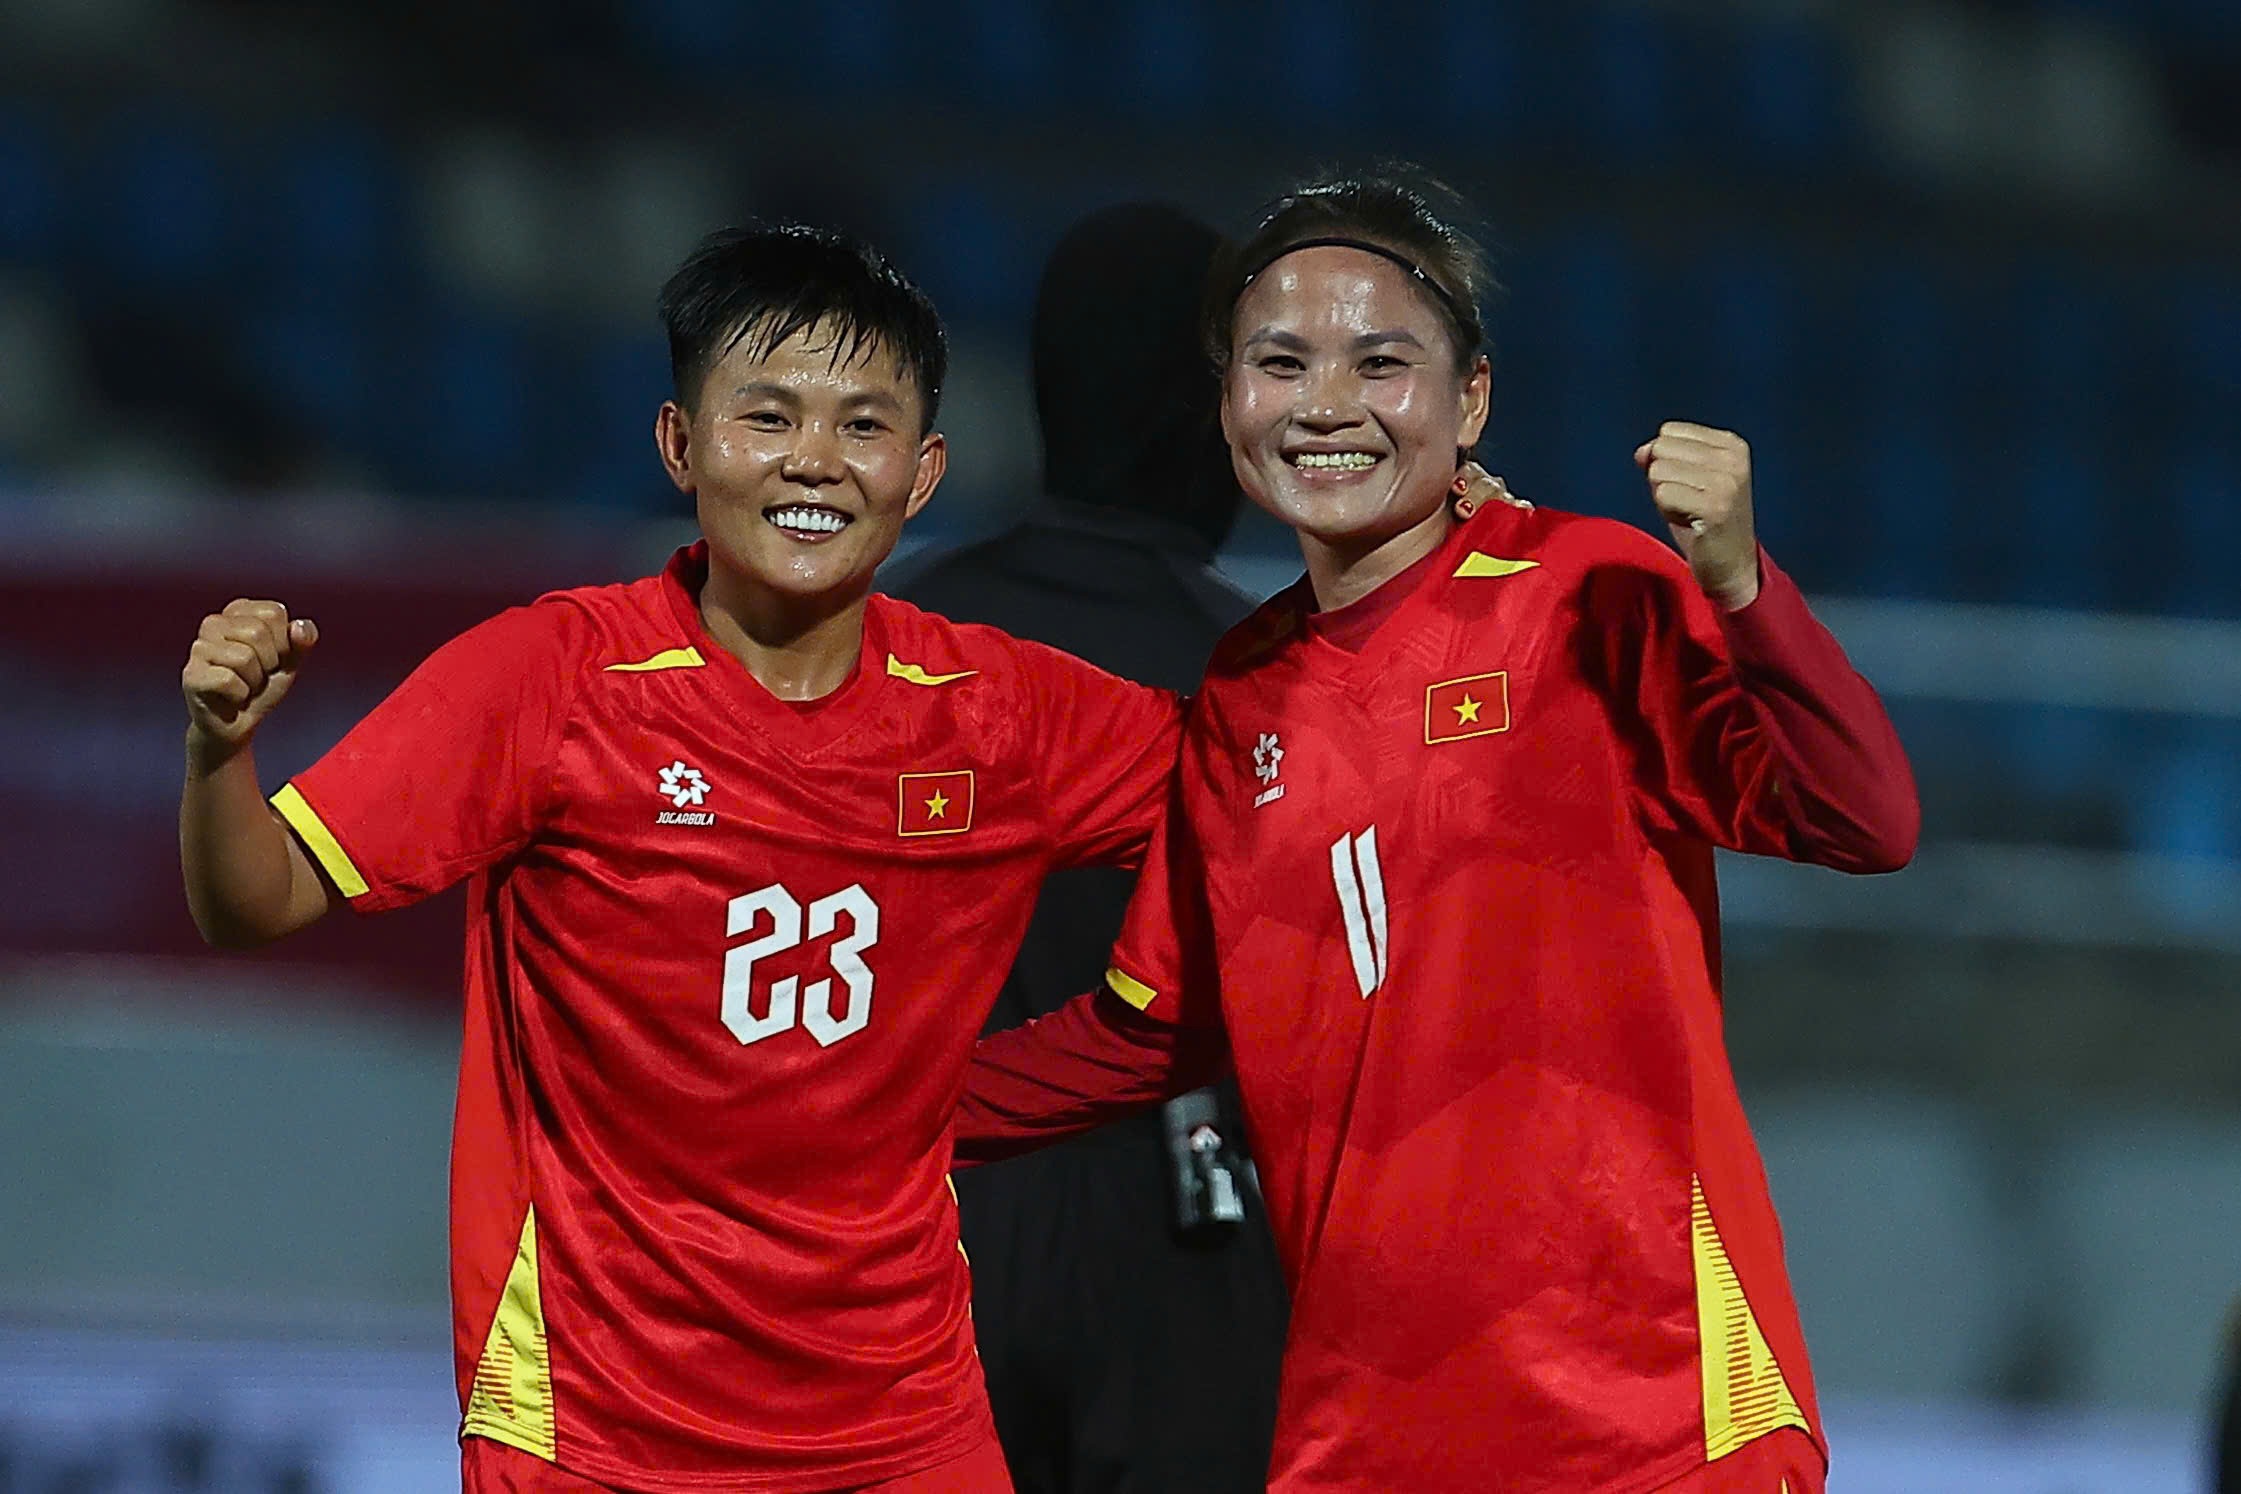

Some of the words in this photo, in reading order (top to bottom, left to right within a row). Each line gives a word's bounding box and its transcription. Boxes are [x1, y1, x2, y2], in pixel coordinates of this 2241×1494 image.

[656, 811, 715, 826] JOCARBOLA
[721, 883, 879, 1047] 23
[1331, 824, 1388, 1000] 11
